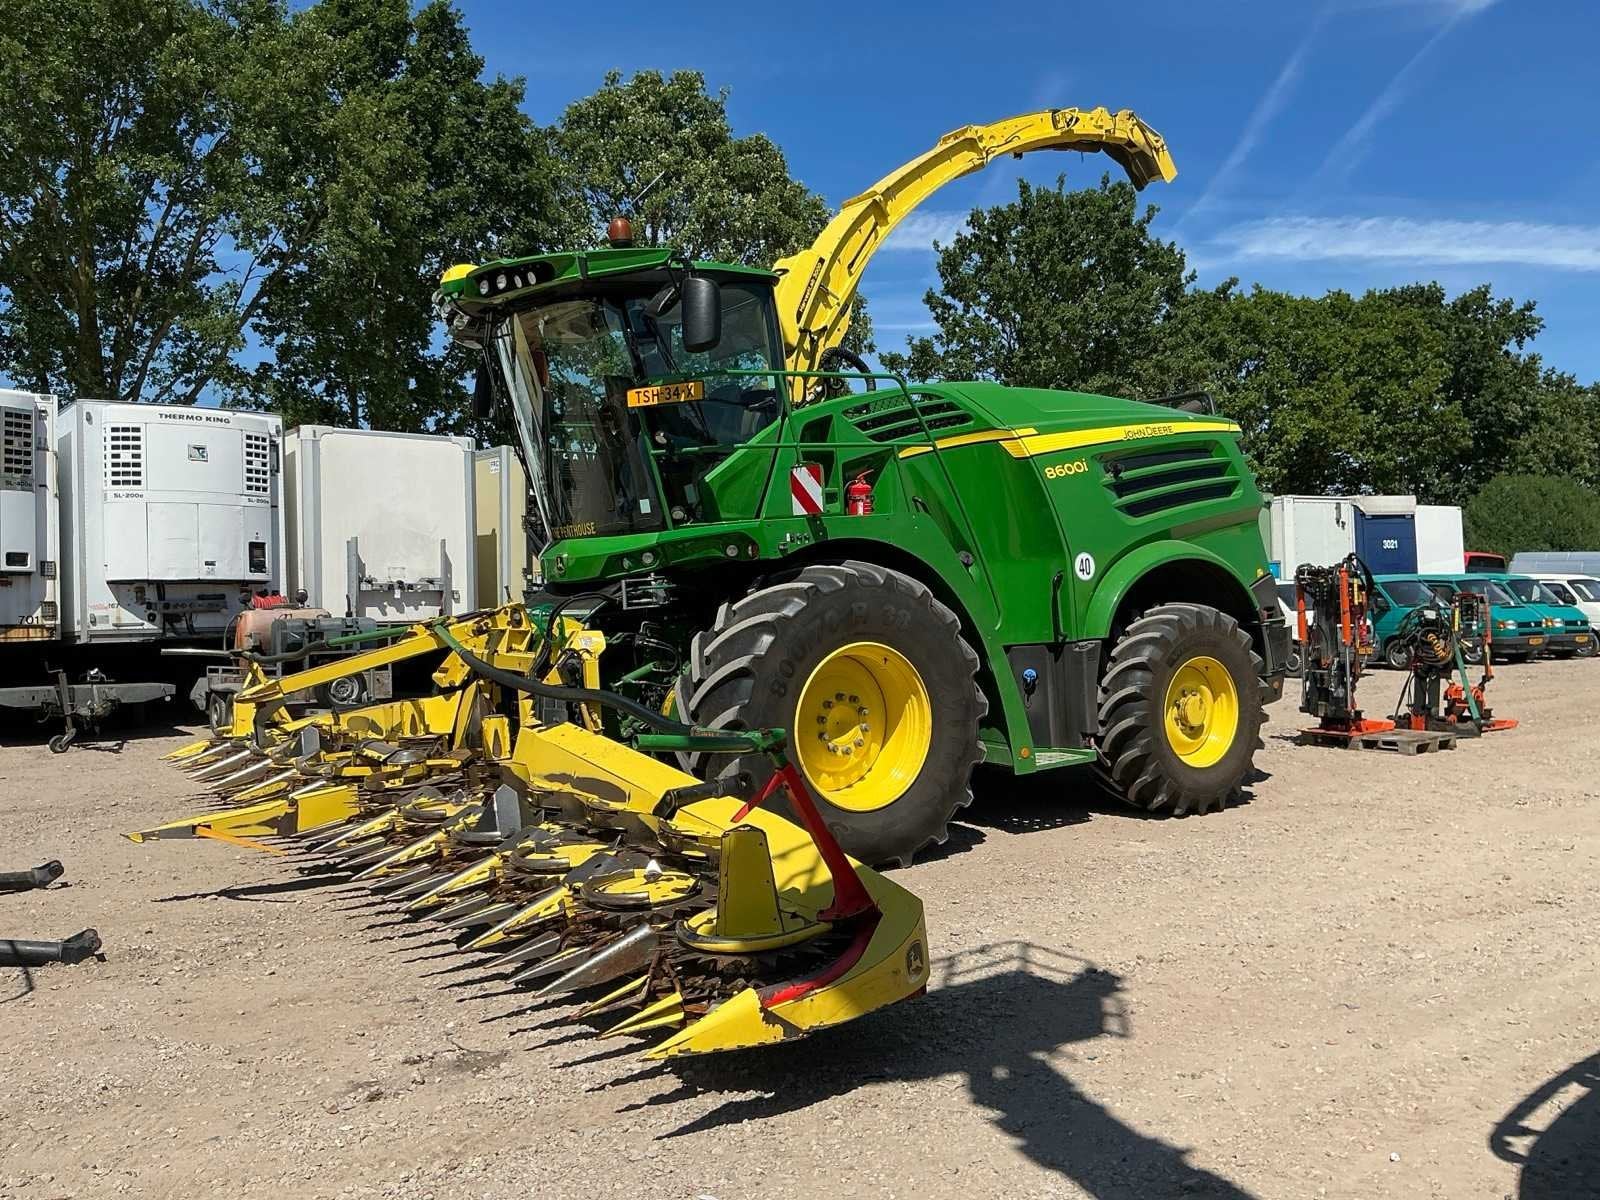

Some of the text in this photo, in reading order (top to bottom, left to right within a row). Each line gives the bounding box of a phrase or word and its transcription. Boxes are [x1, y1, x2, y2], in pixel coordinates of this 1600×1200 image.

[158, 413, 231, 424] THERMO KING
[1123, 426, 1175, 440] JOHN DEERE
[1044, 458, 1089, 479] 8600i
[1382, 539, 1398, 549] 3021
[1079, 557, 1091, 575] 40
[18, 615, 40, 625] 701
